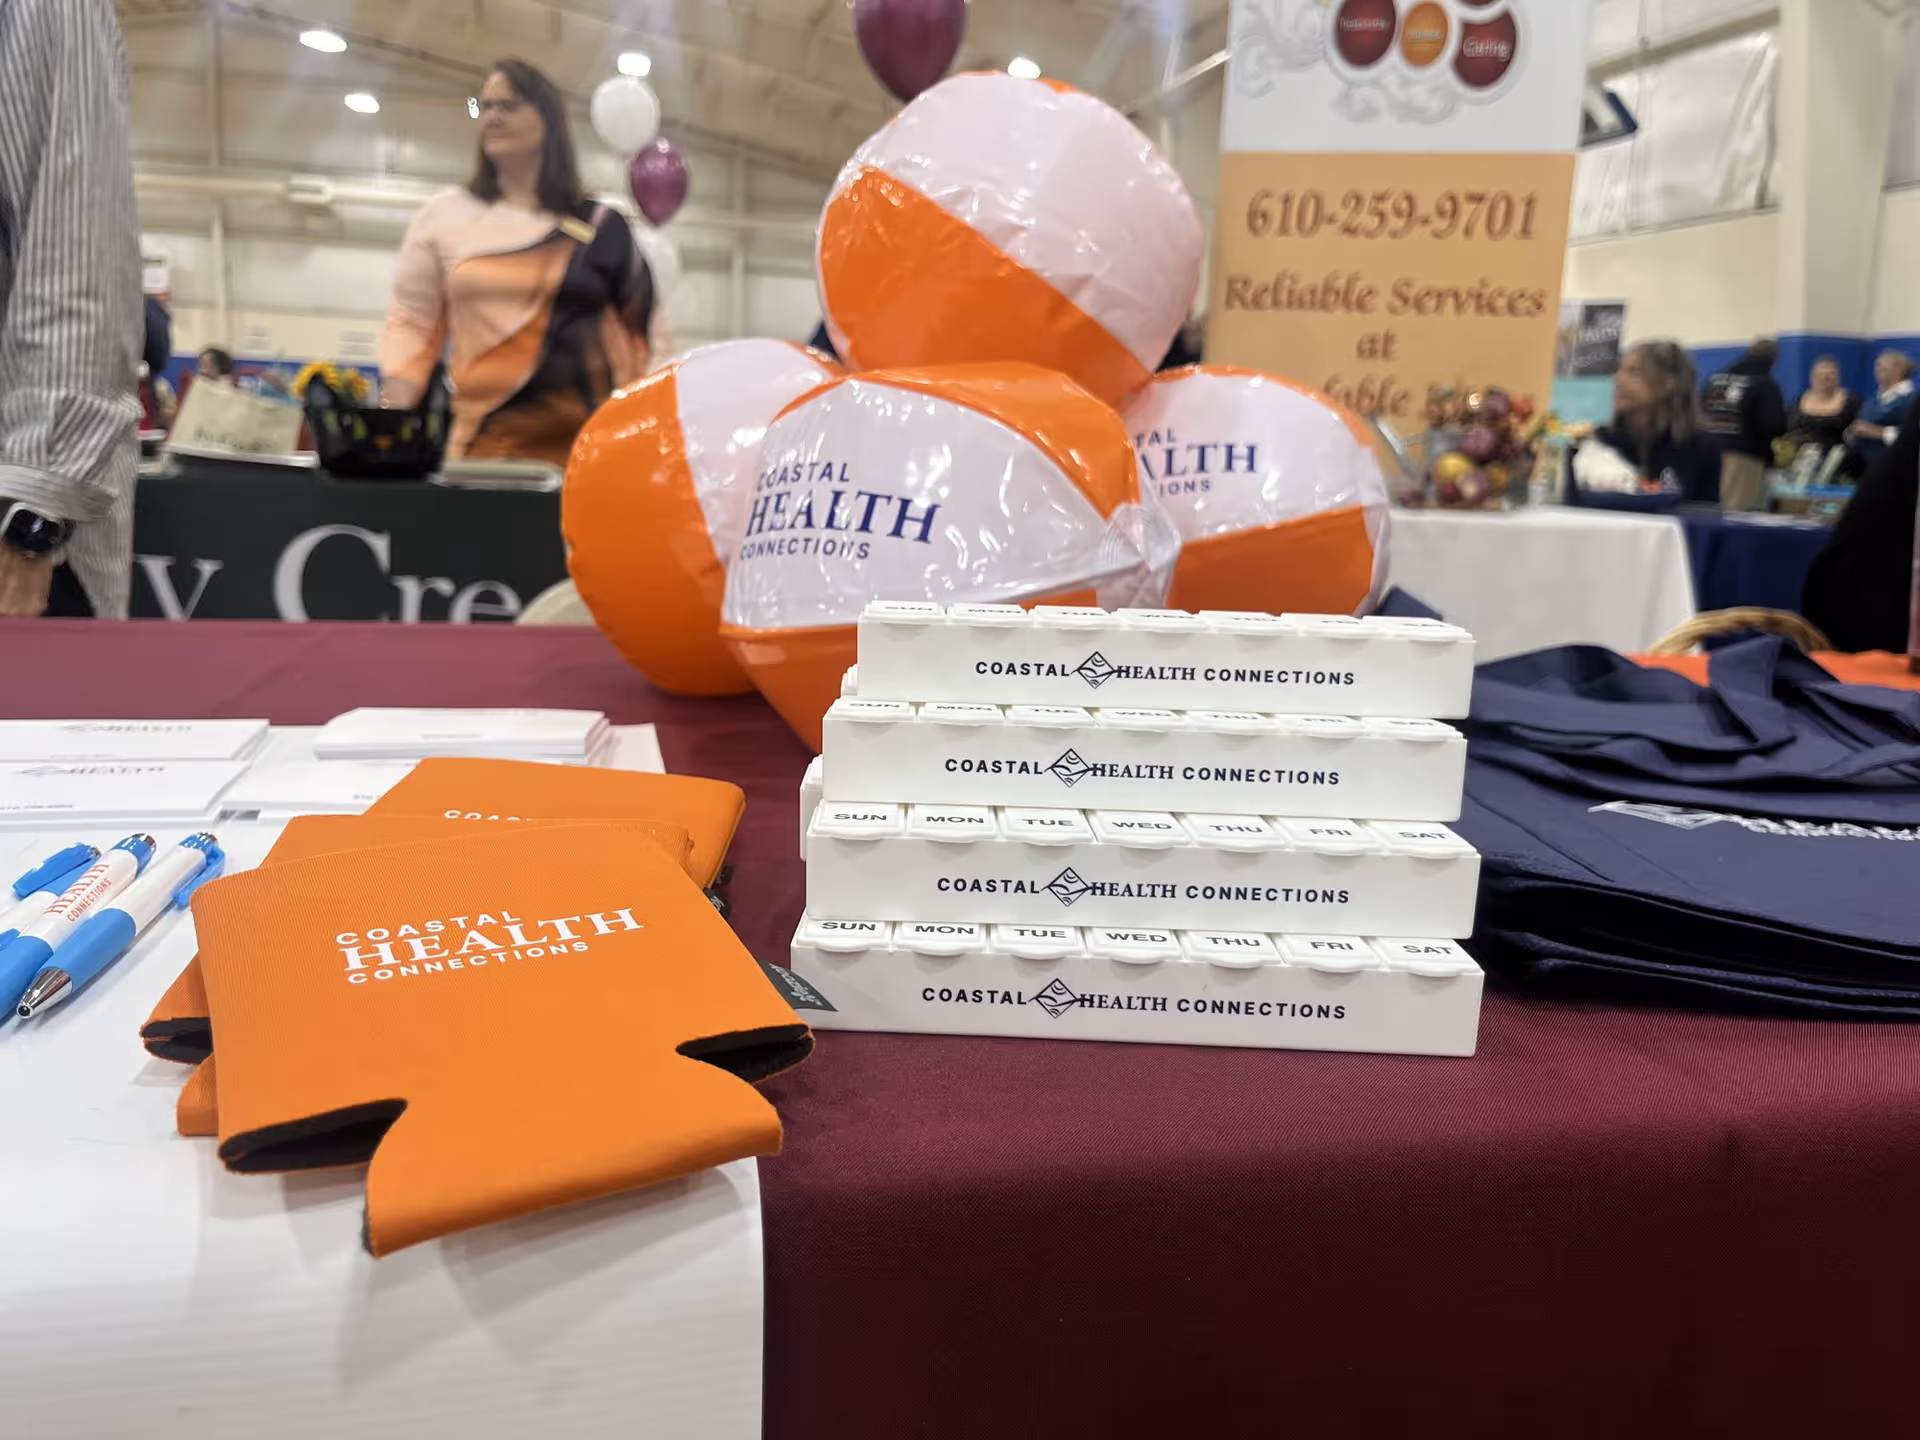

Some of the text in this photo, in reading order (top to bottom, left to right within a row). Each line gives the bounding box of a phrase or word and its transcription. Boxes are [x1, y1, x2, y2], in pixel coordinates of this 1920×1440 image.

[1246, 187, 1538, 241] 610-259-9701
[1225, 270, 1547, 318] Reliable Services
[1356, 328, 1398, 361] at
[757, 462, 850, 491] COASTAL
[745, 489, 942, 544] HEALTH
[740, 537, 871, 560] CONNECTIONS
[975, 661, 1354, 686] COASTAL HEALTH CONNECTIONS
[945, 758, 1339, 786] COASTAL HEALTH CONNECTIONS
[834, 813, 1449, 841] SUN MON TUE WED THU FRI SAT
[67, 878, 112, 922] CONNECTIONS
[937, 877, 1349, 904] COASTAL HEALTH CONNECTIONS
[335, 910, 521, 945] COASTAL
[339, 907, 645, 971] HEALTH
[821, 921, 1453, 956] SUN MON TUE WED THU FRI SAT
[347, 940, 589, 984] CONNECTIONS
[921, 987, 1346, 1020] COASTAL HEALTH CONNECTIONS
